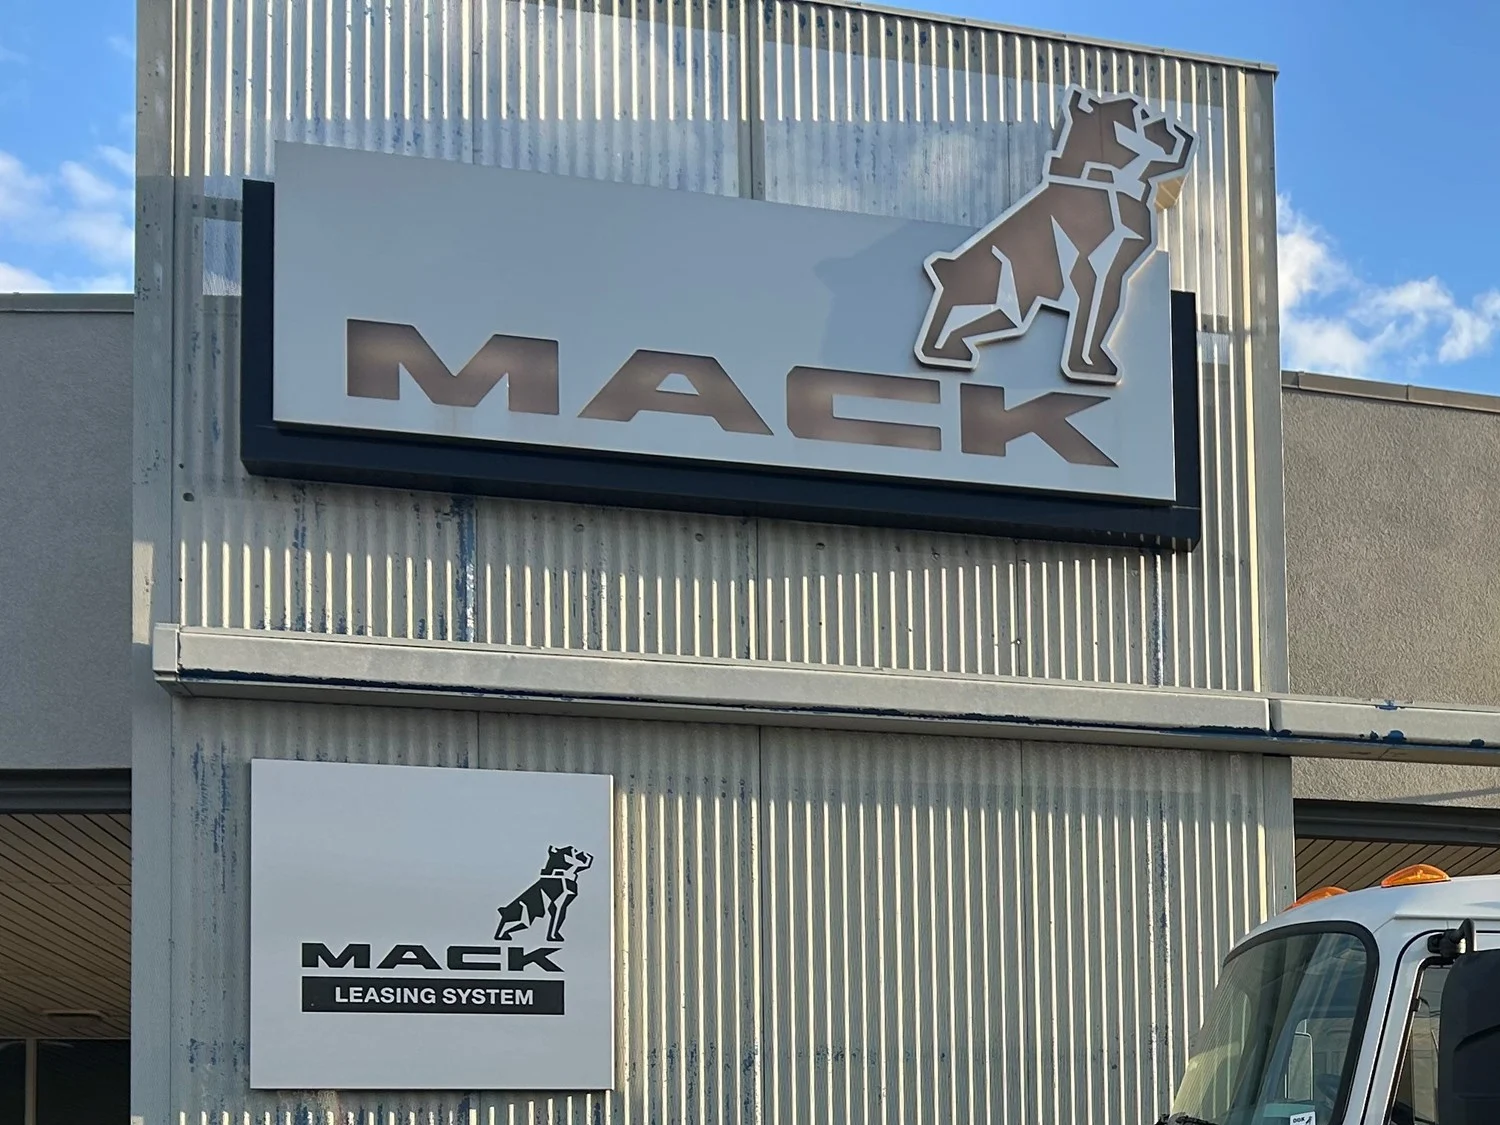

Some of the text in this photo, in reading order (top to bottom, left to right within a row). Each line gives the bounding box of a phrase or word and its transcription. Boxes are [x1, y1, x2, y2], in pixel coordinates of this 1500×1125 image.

[347, 318, 1117, 468] MACK
[301, 942, 565, 973] MACK
[334, 986, 534, 1006] LEASING SYSTEM
